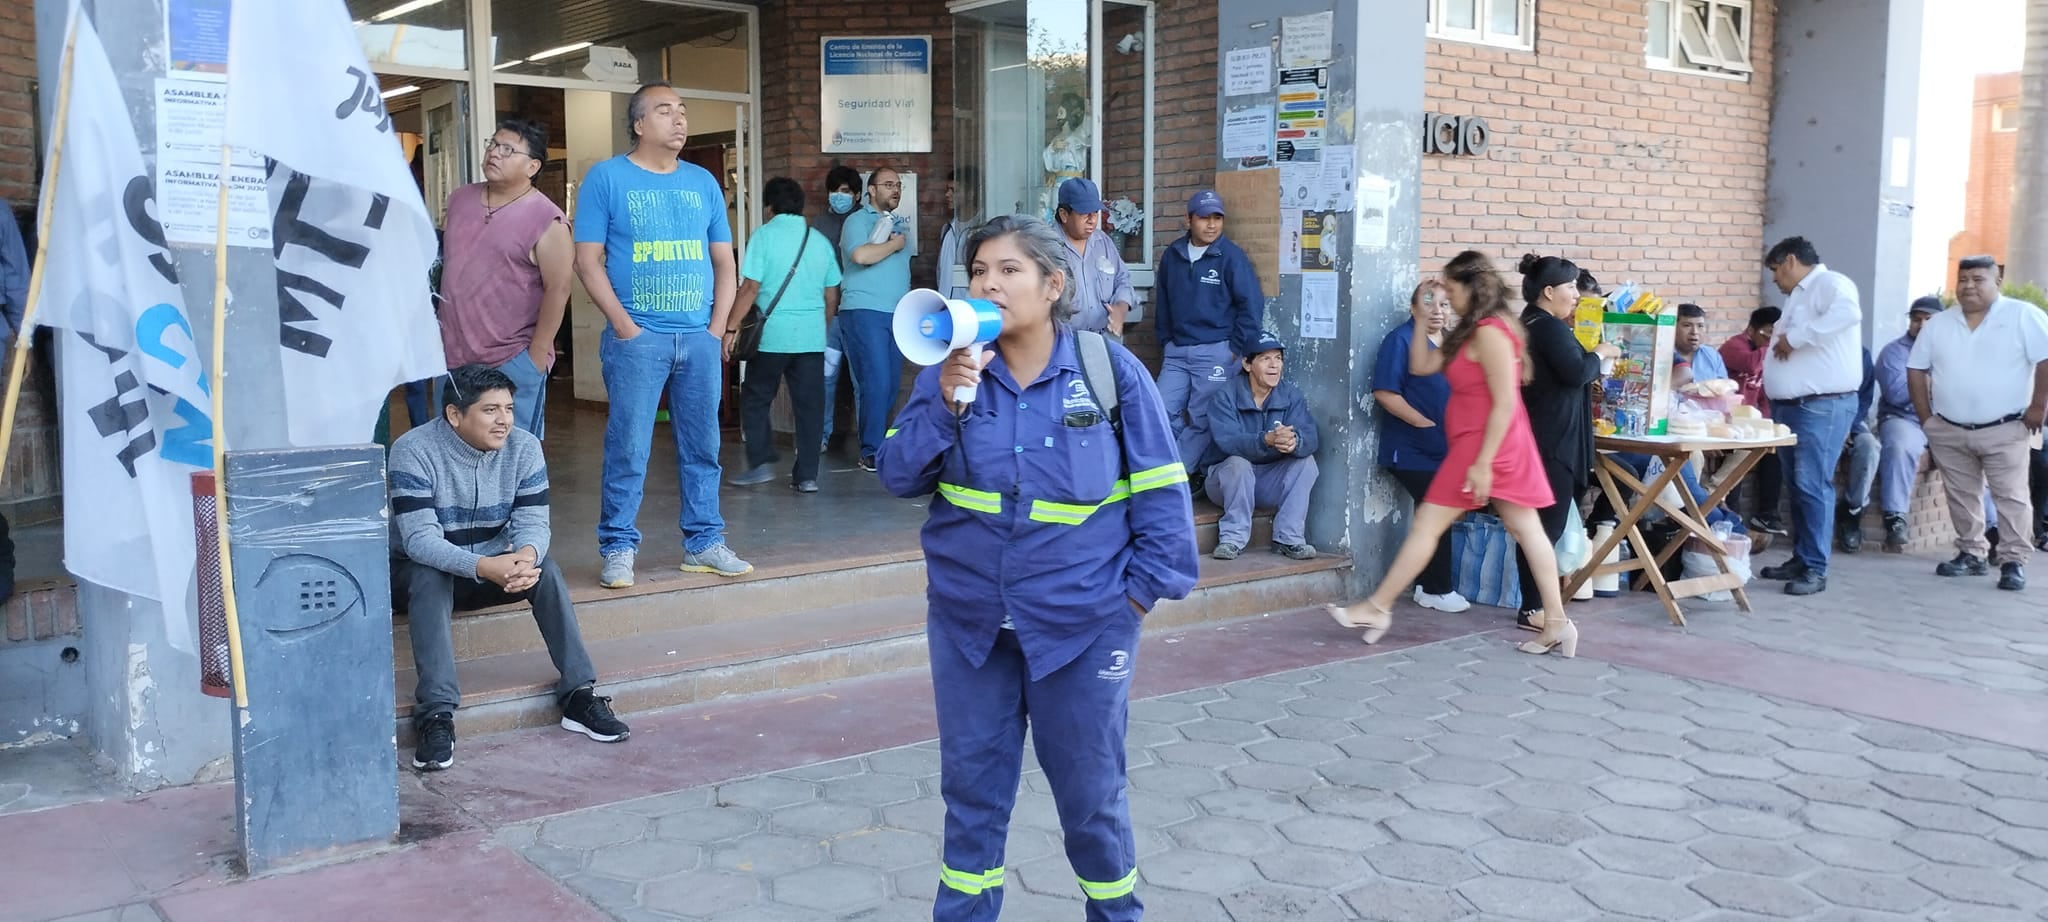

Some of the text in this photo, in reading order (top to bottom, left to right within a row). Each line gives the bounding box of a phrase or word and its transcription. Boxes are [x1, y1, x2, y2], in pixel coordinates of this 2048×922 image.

[163, 88, 221, 99] ASAMBLEA
[838, 99, 914, 110] Seguridad Vial
[164, 169, 220, 181] ASAMBLEA
[632, 239, 704, 263] SPORTIVO
